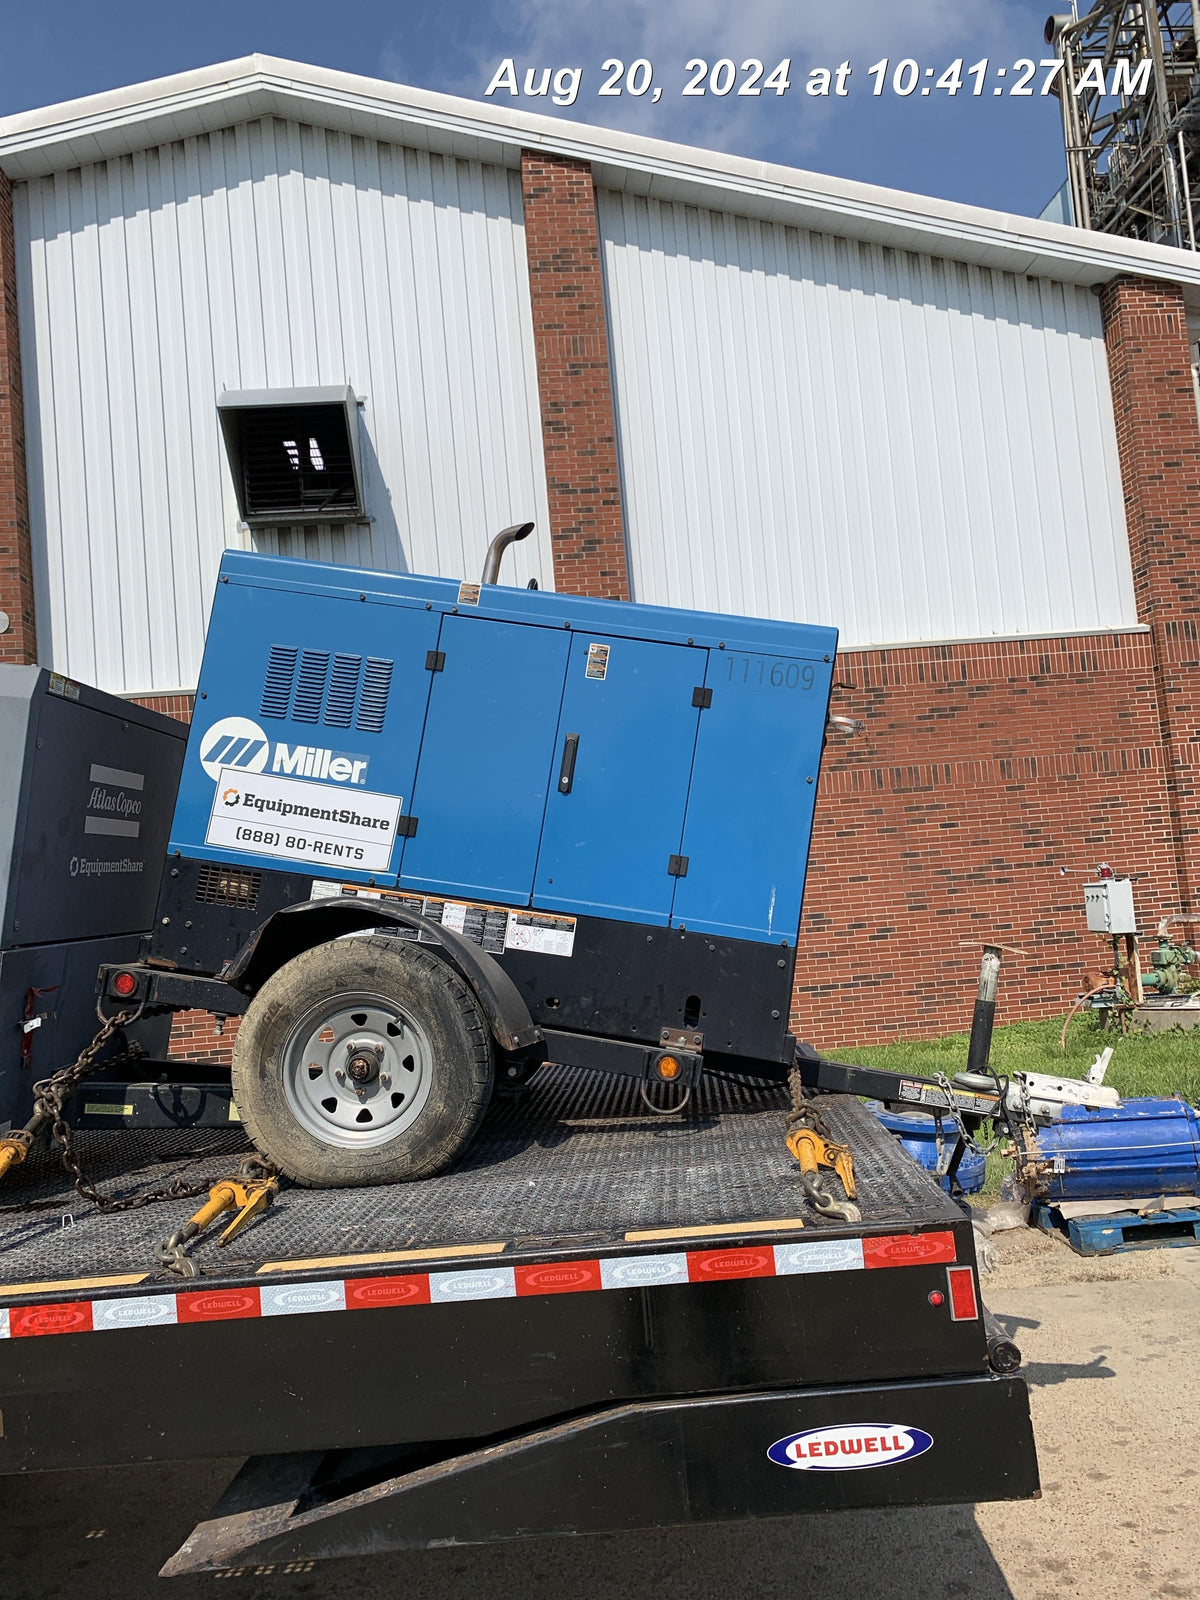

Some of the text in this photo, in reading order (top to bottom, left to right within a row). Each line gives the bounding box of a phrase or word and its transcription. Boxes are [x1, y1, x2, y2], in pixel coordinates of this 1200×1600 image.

[727, 656, 815, 691] 111609
[272, 742, 367, 784] Miller
[87, 787, 142, 817] Atlas Copco
[242, 793, 390, 831] EquipmentShare
[235, 826, 365, 860] (888) 80-RENTS
[79, 858, 144, 874] EquipmentShare
[626, 1266, 666, 1275] LEDWELL
[714, 1259, 754, 1268] LEDWELL
[453, 1280, 491, 1289] LEDWELL
[539, 1273, 579, 1282] LEDWELL
[367, 1287, 406, 1296] LEDWELL
[202, 1300, 242, 1309] LEDWELL
[795, 1435, 905, 1459] LEDWELL
